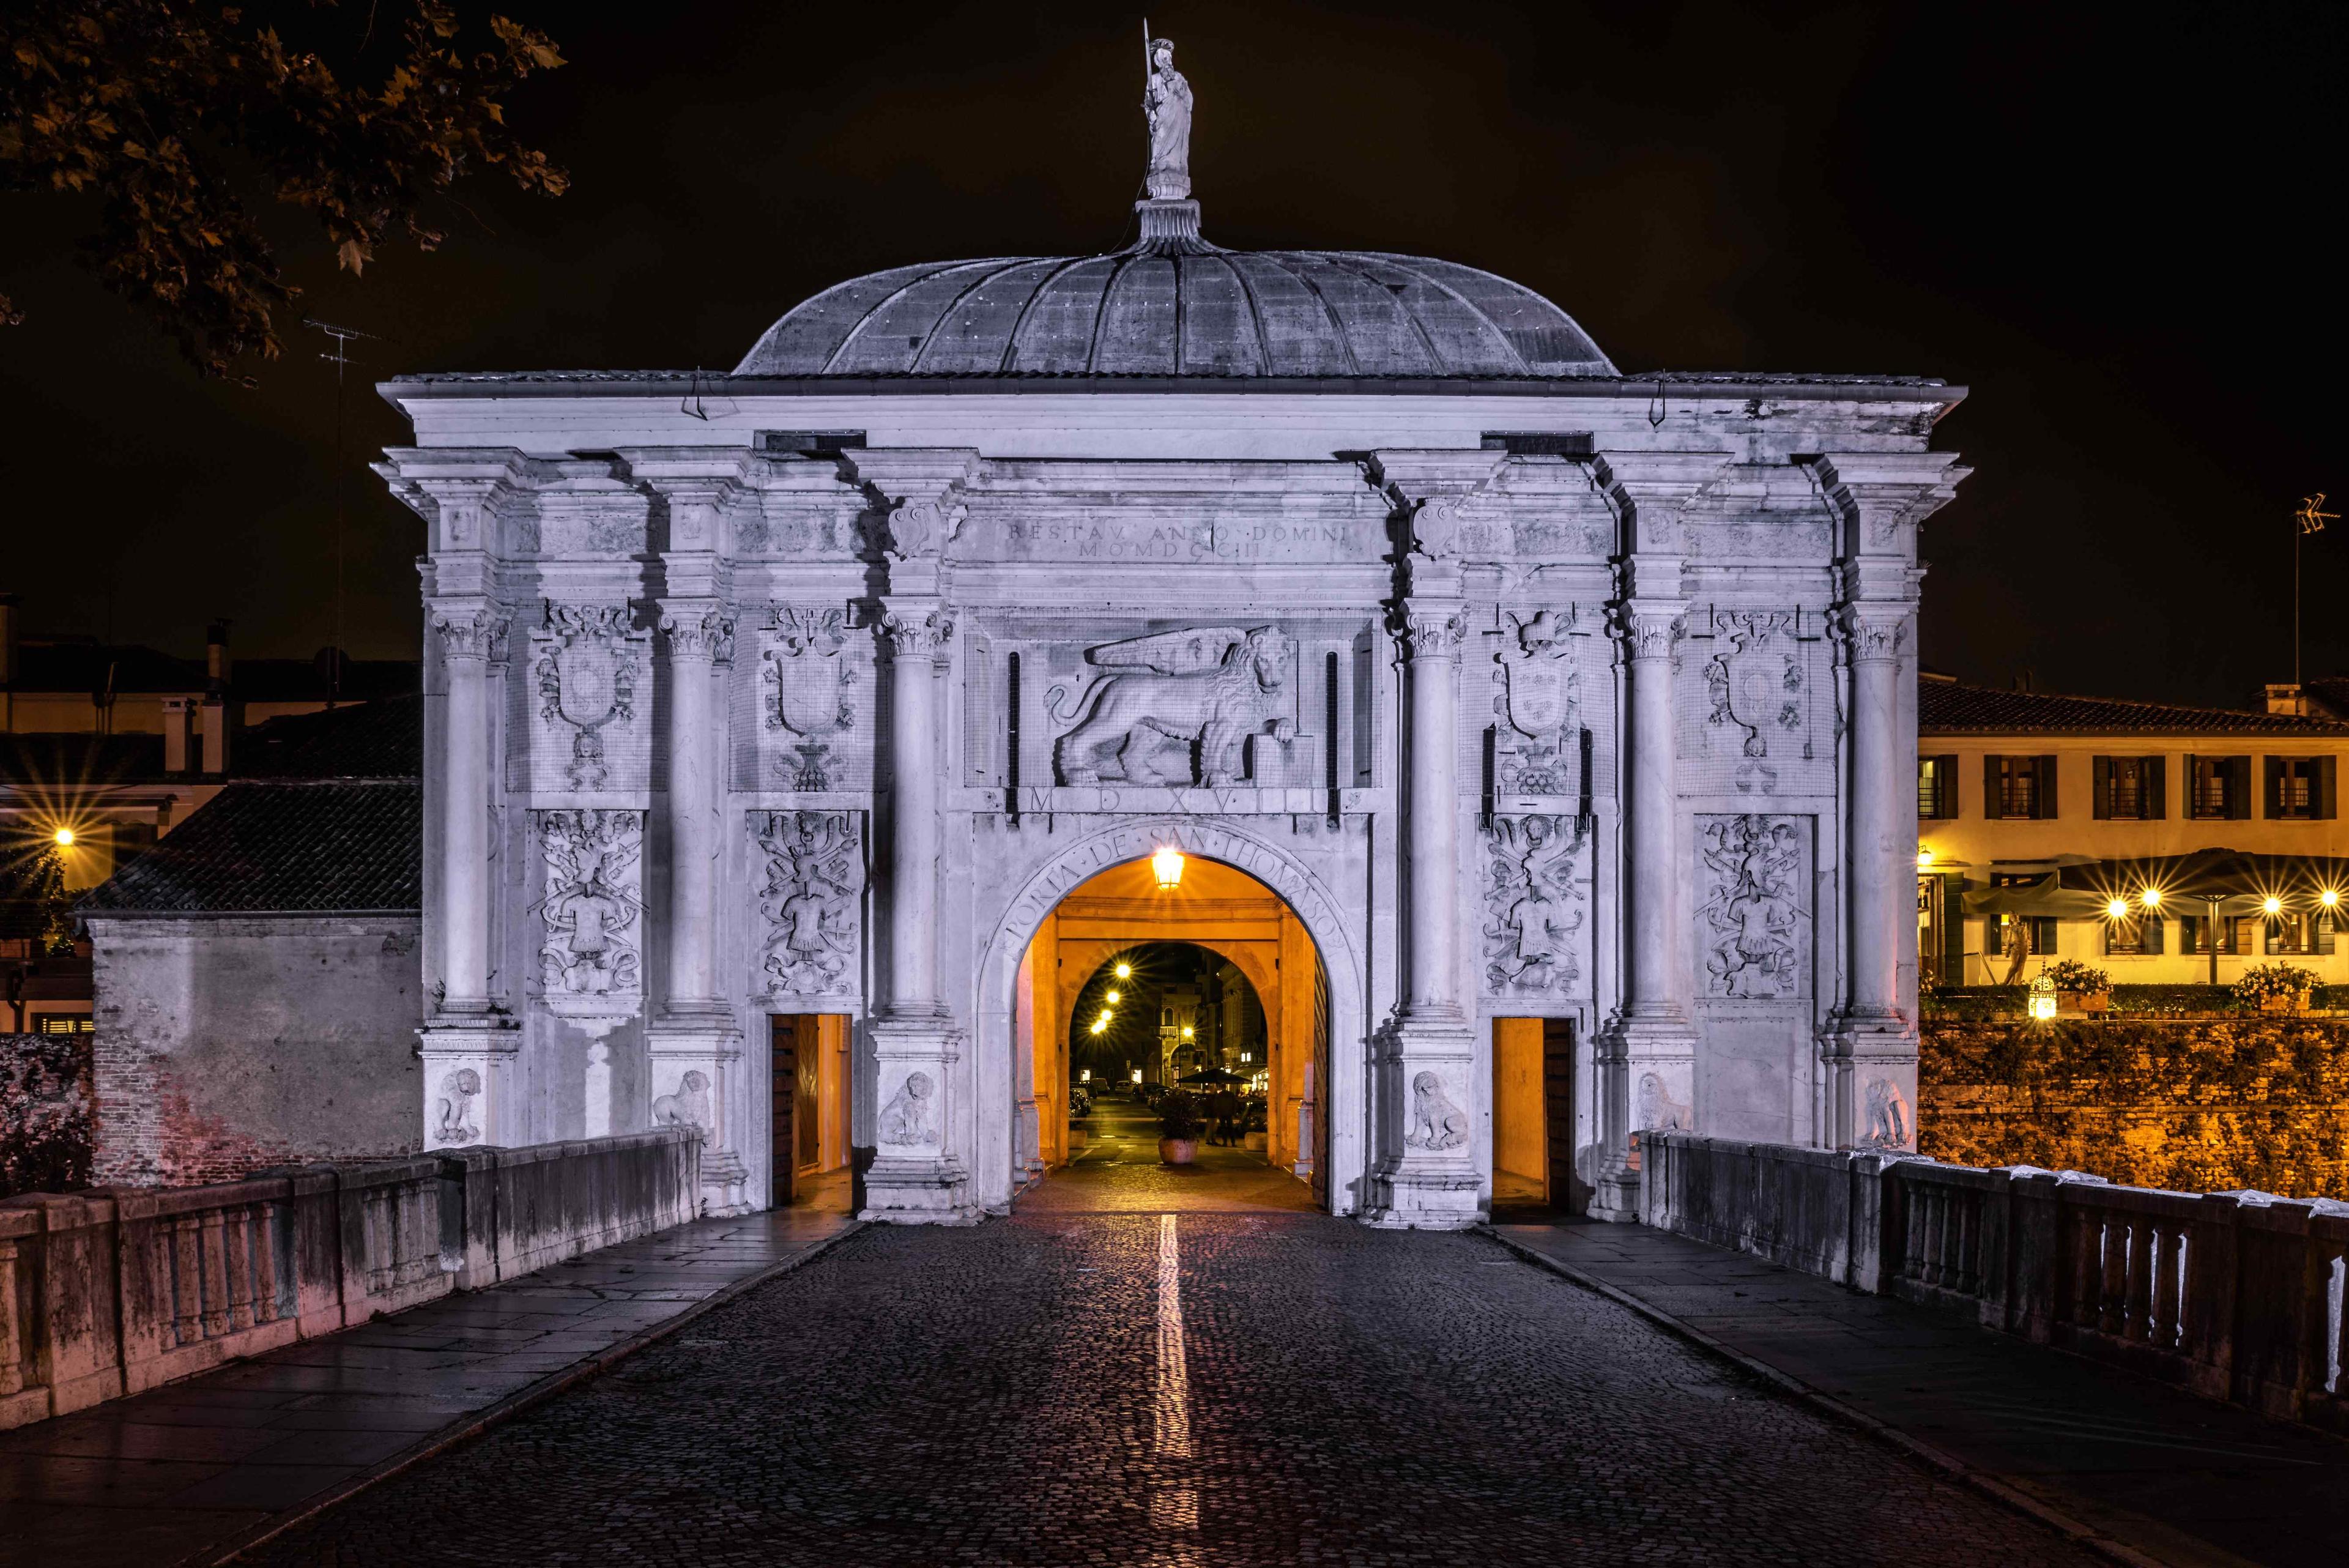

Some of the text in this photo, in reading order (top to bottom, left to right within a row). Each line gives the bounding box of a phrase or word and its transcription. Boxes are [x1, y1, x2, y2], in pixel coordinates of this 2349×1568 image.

[1151, 526, 1228, 541] ANO
[1253, 526, 1346, 541] DOMINI
[1005, 863, 1081, 940] PORTA
[1089, 834, 1129, 866] DE
[1150, 826, 1208, 850] SAN
